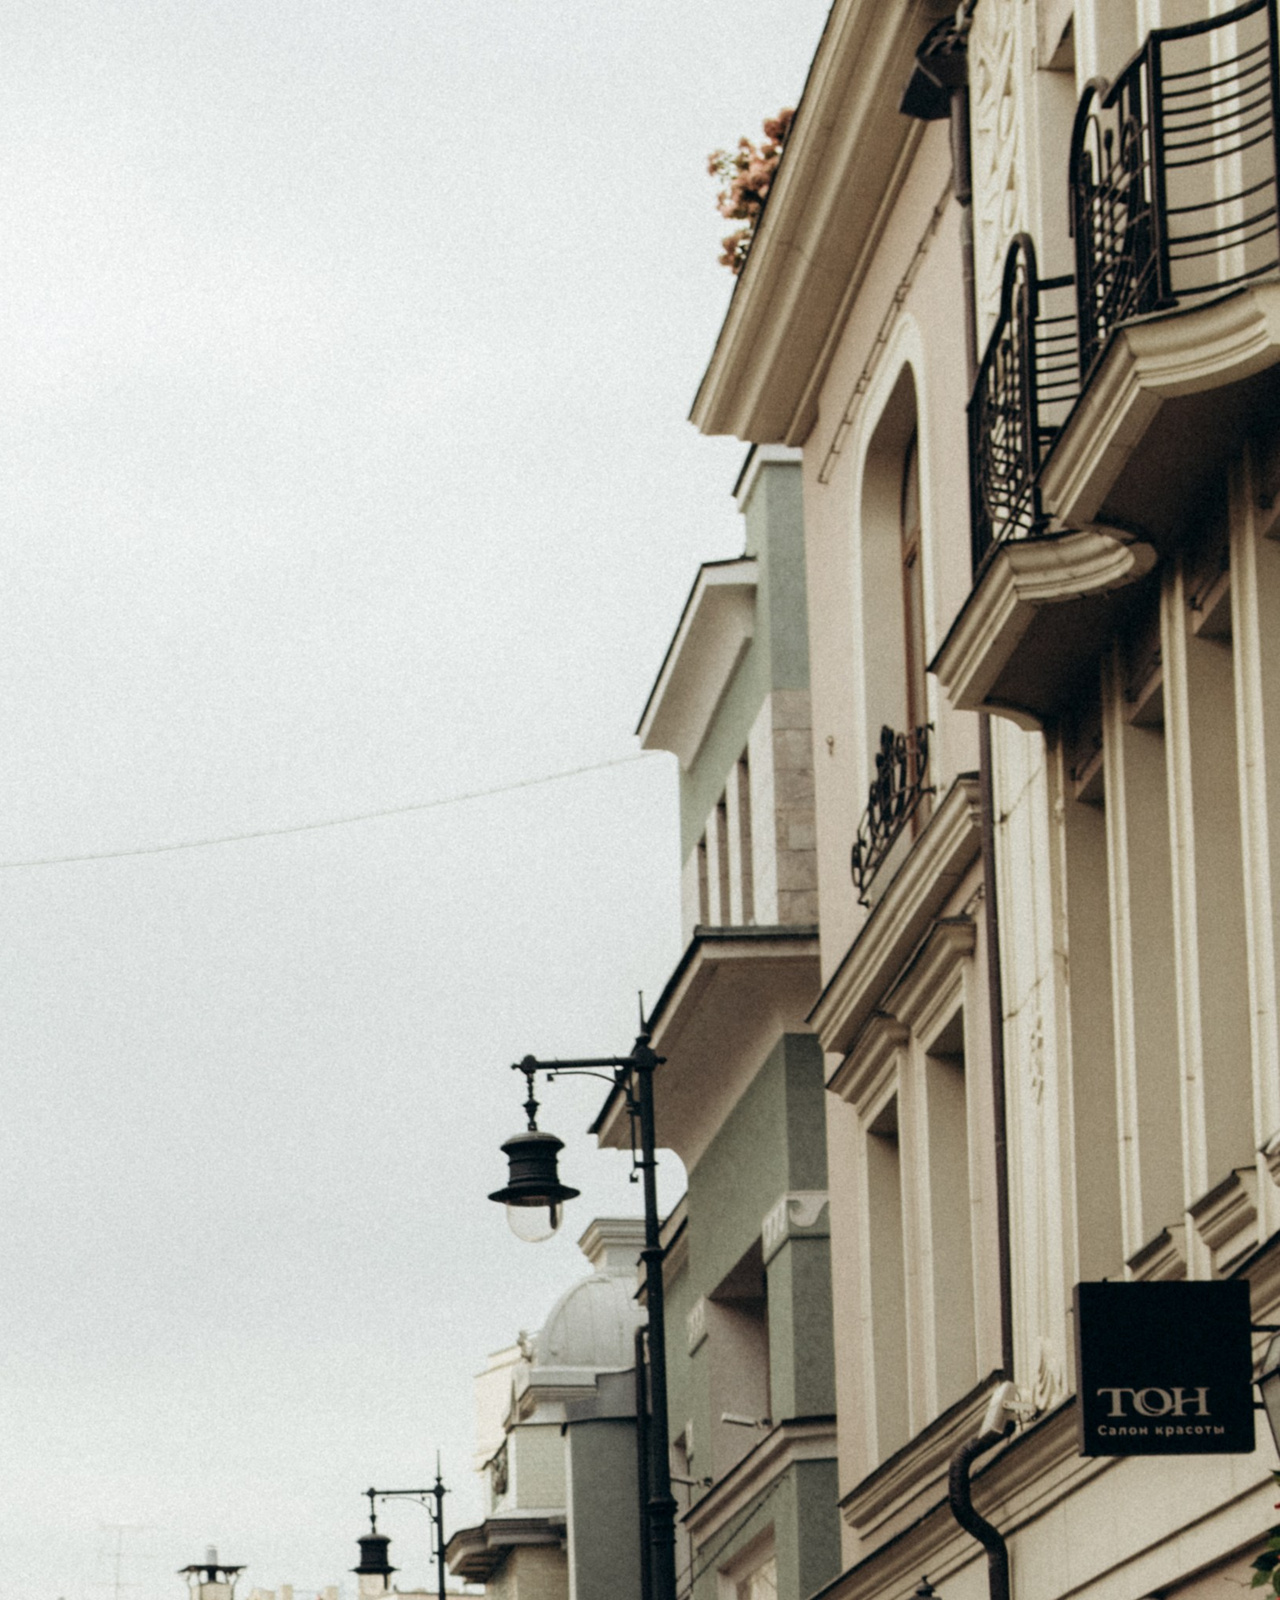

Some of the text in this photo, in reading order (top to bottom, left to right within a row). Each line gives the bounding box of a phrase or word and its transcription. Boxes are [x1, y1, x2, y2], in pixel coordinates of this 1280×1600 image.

[1097, 1387, 1212, 1417] ТОН
[1097, 1425, 1225, 1438] Салон красоты
